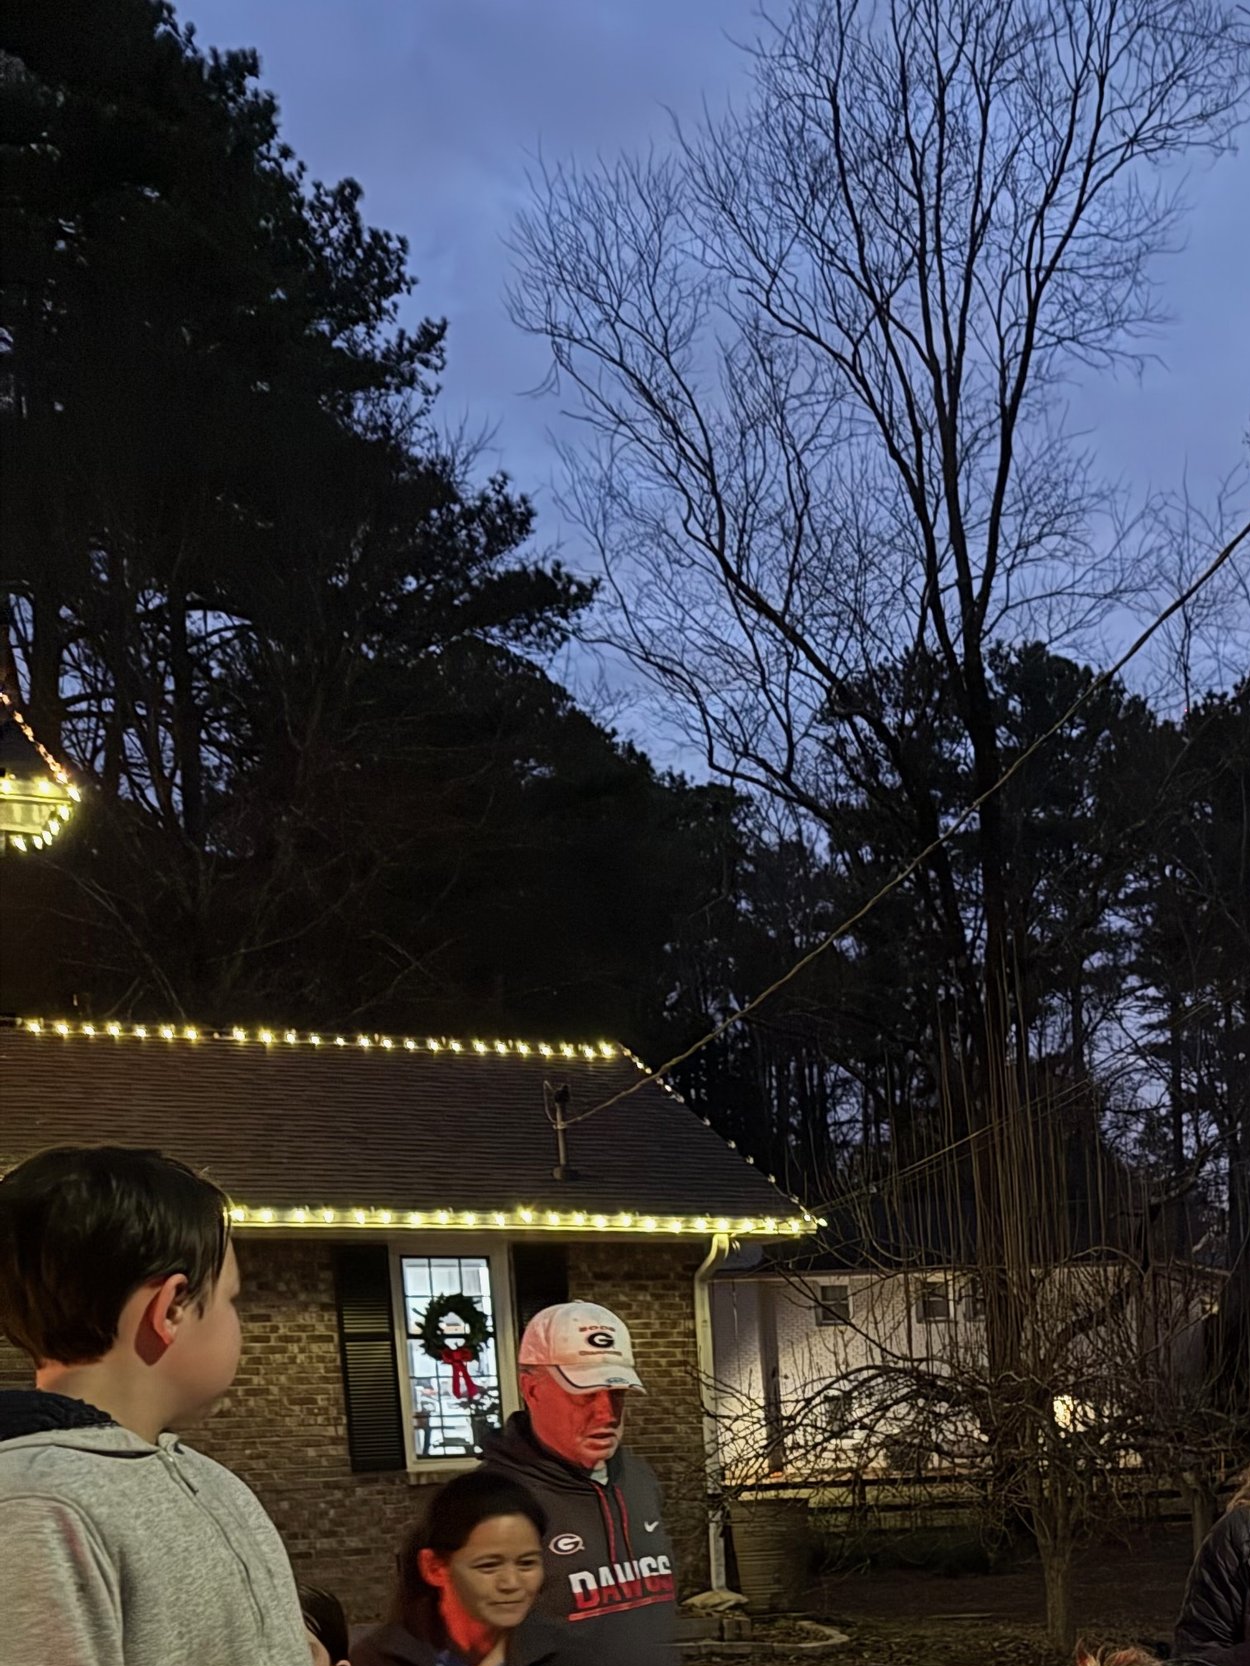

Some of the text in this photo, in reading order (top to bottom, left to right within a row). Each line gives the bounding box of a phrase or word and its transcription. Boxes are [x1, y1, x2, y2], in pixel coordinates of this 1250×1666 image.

[587, 1332, 615, 1349] G
[549, 1533, 585, 1555] G
[568, 1555, 673, 1609] DAWGS
